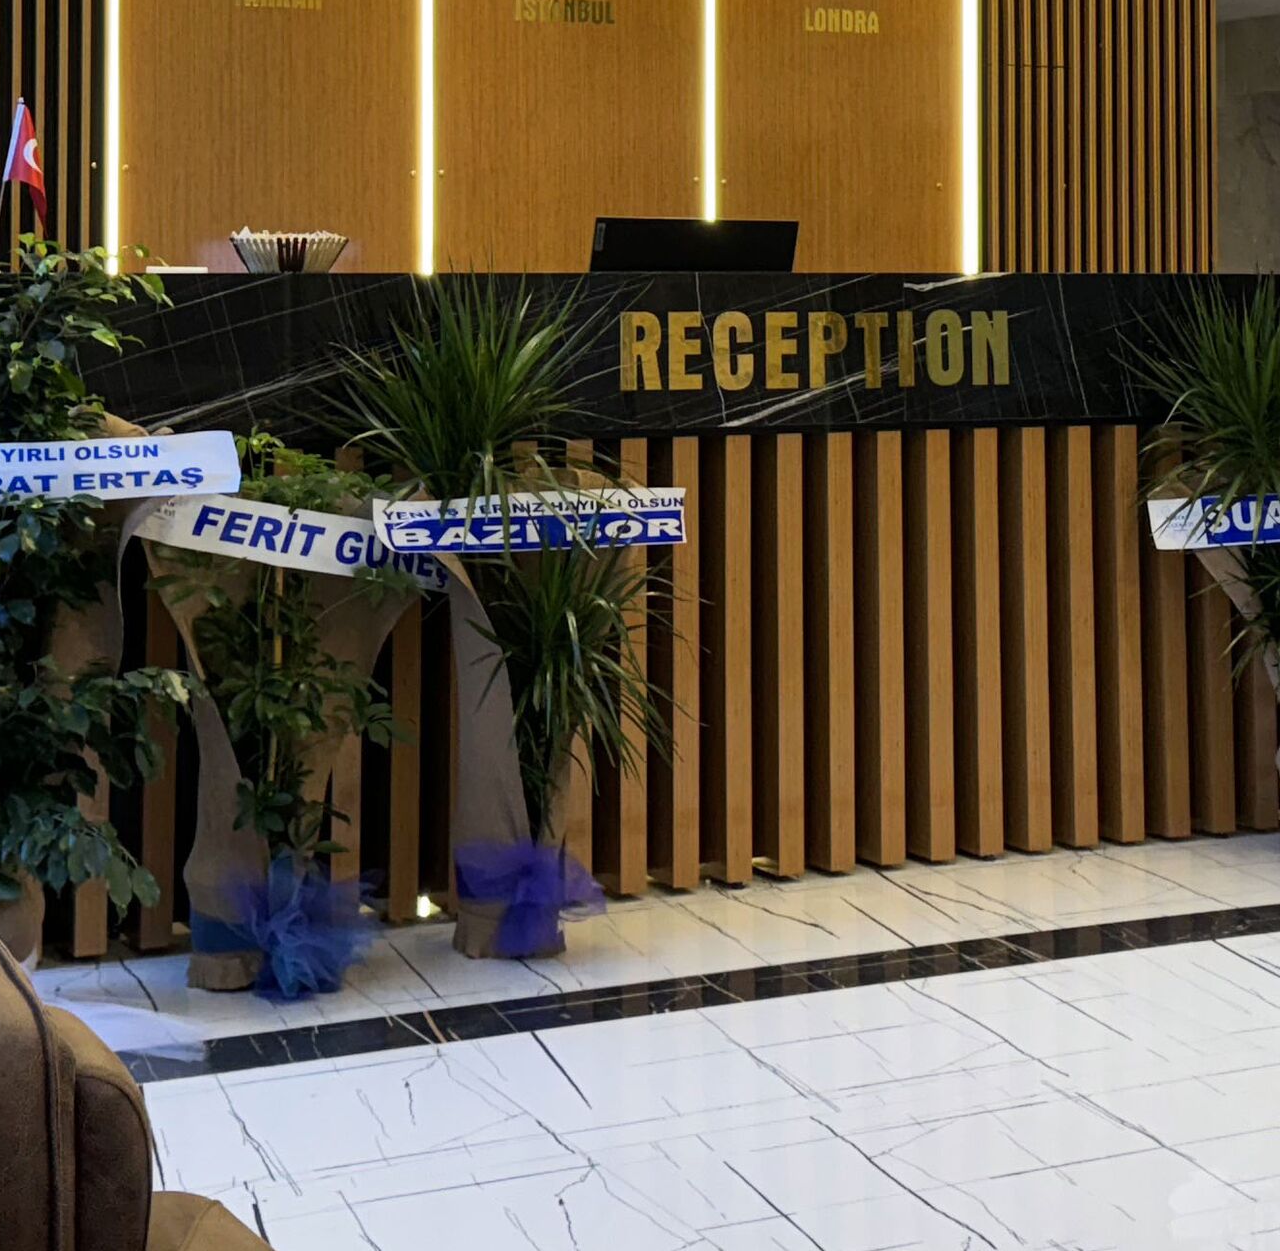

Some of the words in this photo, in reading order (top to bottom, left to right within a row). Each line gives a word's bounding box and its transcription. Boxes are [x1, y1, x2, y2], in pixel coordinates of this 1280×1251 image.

[803, 7, 879, 34] LONDRA
[620, 309, 1010, 391] RECEPTION
[75, 443, 159, 461] OLSUN
[73, 466, 204, 491] ERTAŞ
[628, 497, 684, 508] OLSUN
[192, 504, 325, 558] FERİT
